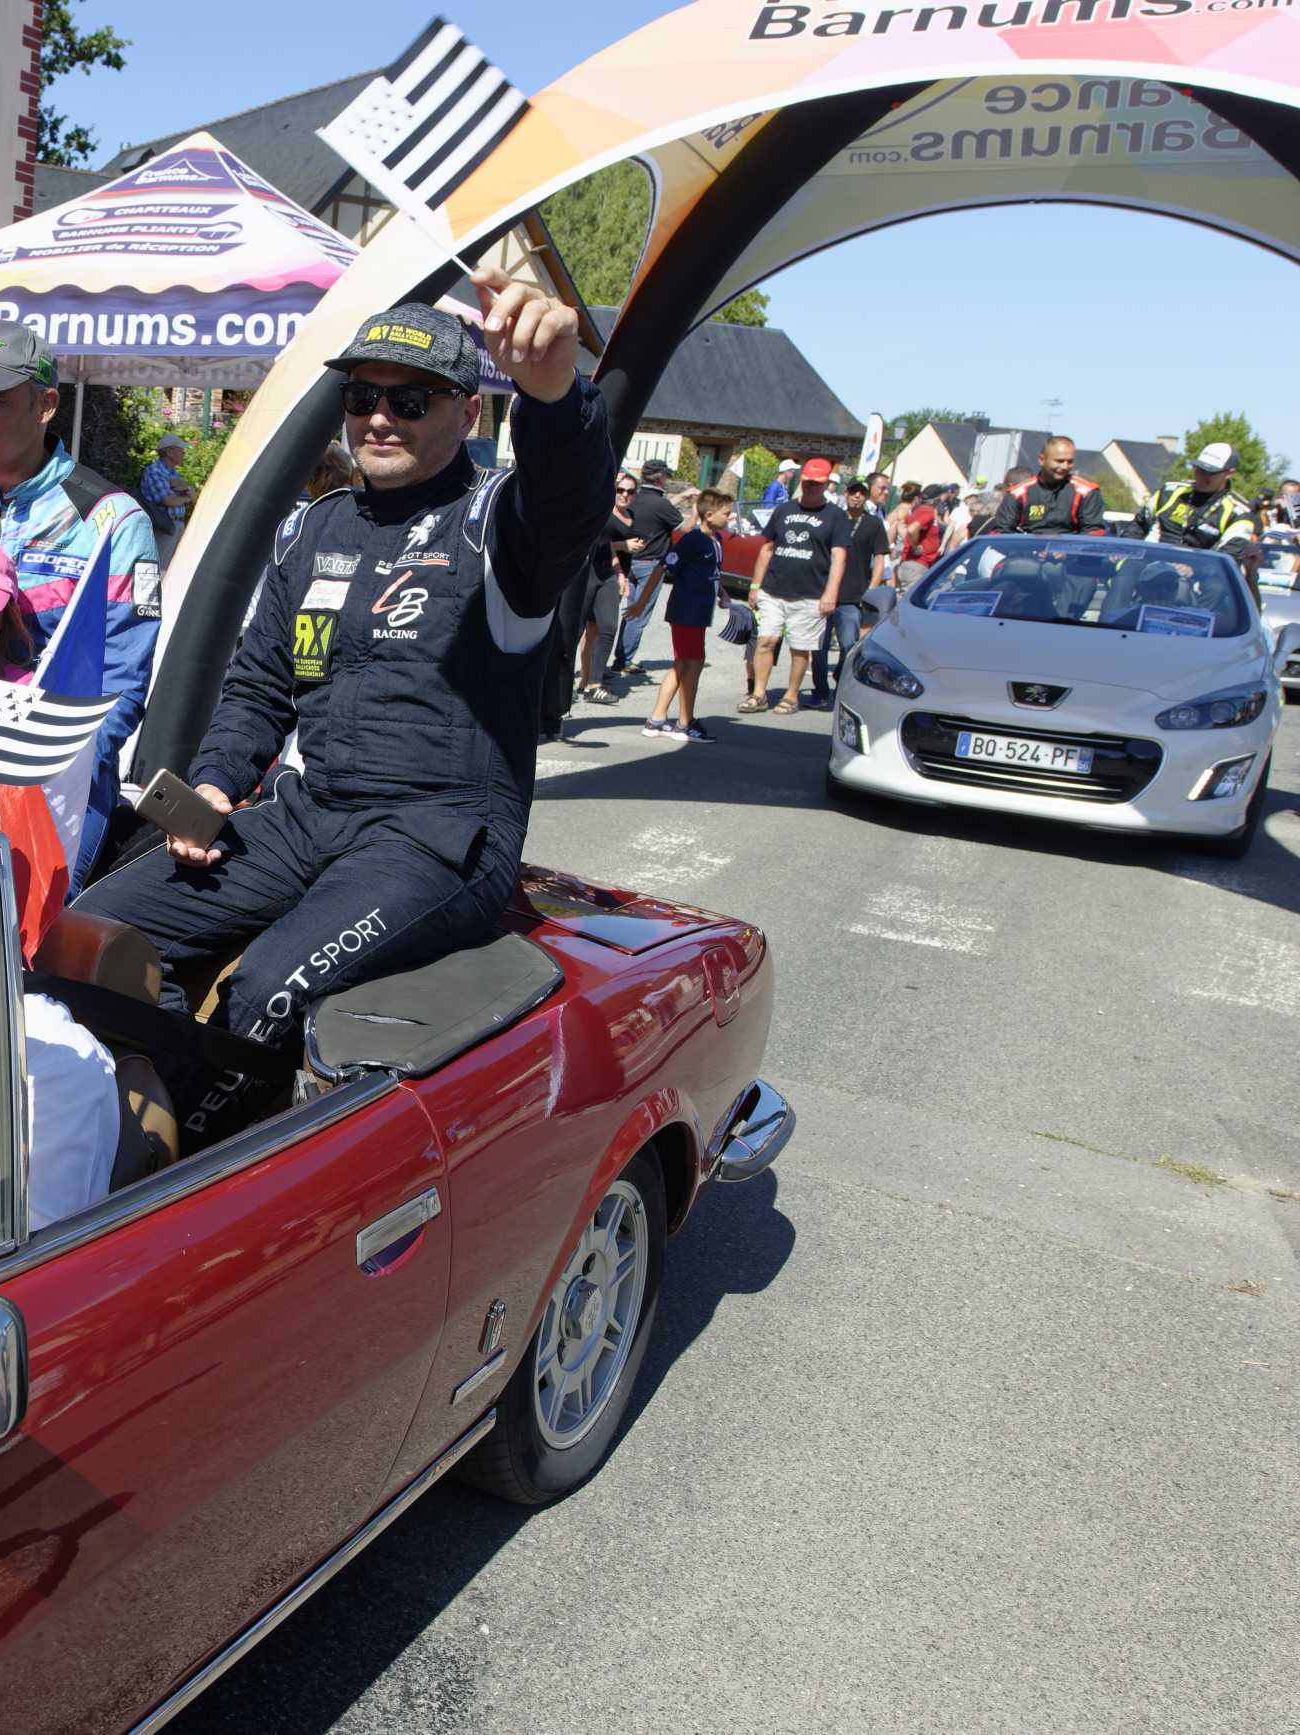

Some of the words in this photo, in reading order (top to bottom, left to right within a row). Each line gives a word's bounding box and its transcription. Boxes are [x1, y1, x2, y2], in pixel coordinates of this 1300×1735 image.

[114, 206, 213, 216] CHAPITEAUX
[57, 225, 130, 239] BARNUMS
[131, 225, 198, 234] PLIANTS
[28, 244, 102, 257] MOBILIER
[105, 243, 123, 251] de
[131, 240, 221, 252] RÉCEPTION
[422, 551, 450, 560] SPORT
[372, 628, 418, 640] RACING
[309, 907, 388, 975] SPORT
